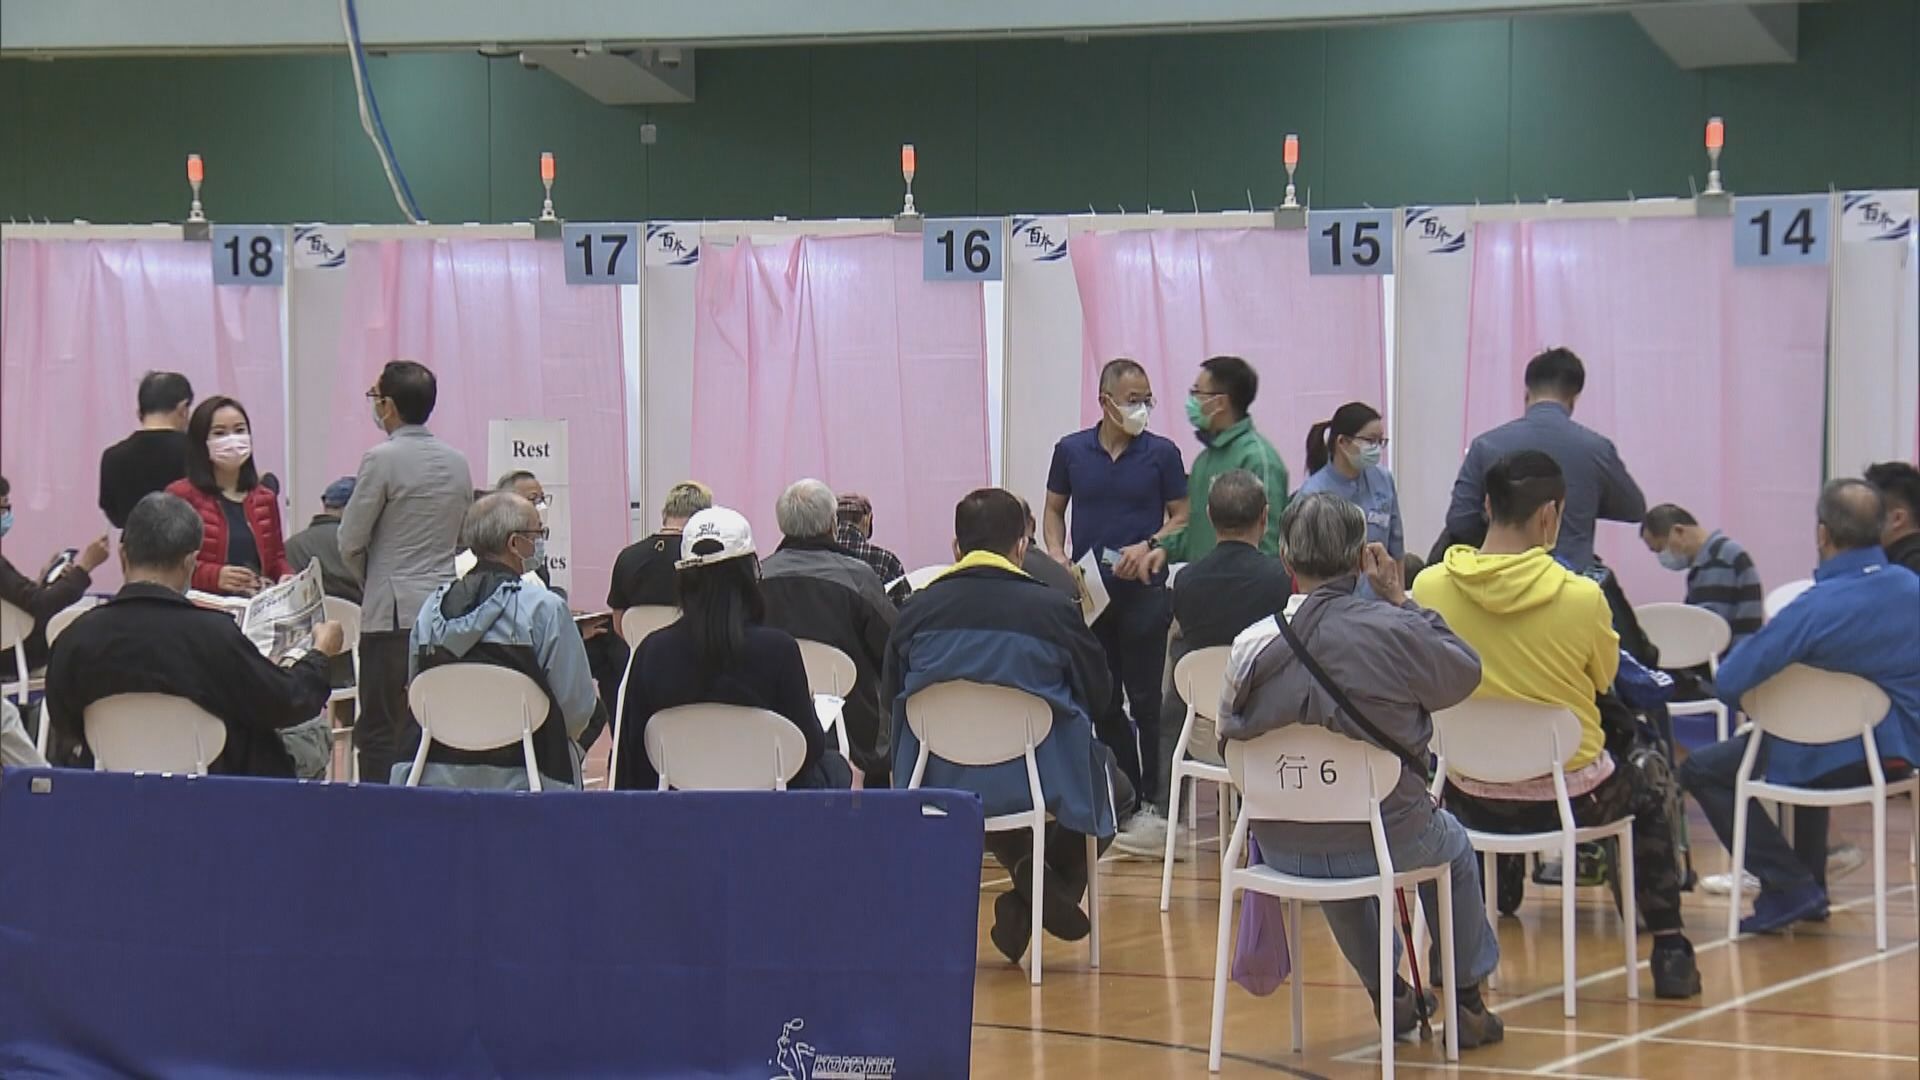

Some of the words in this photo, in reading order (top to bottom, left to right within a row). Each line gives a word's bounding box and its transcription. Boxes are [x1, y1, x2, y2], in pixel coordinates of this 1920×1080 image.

[936, 229, 991, 273] 16
[1322, 221, 1380, 267] 15
[1750, 207, 1816, 256] 14
[224, 235, 273, 278] 18
[575, 233, 628, 276] 17
[512, 440, 550, 457] Rest
[1275, 753, 1308, 790] 行
[1320, 759, 1337, 785] 6
